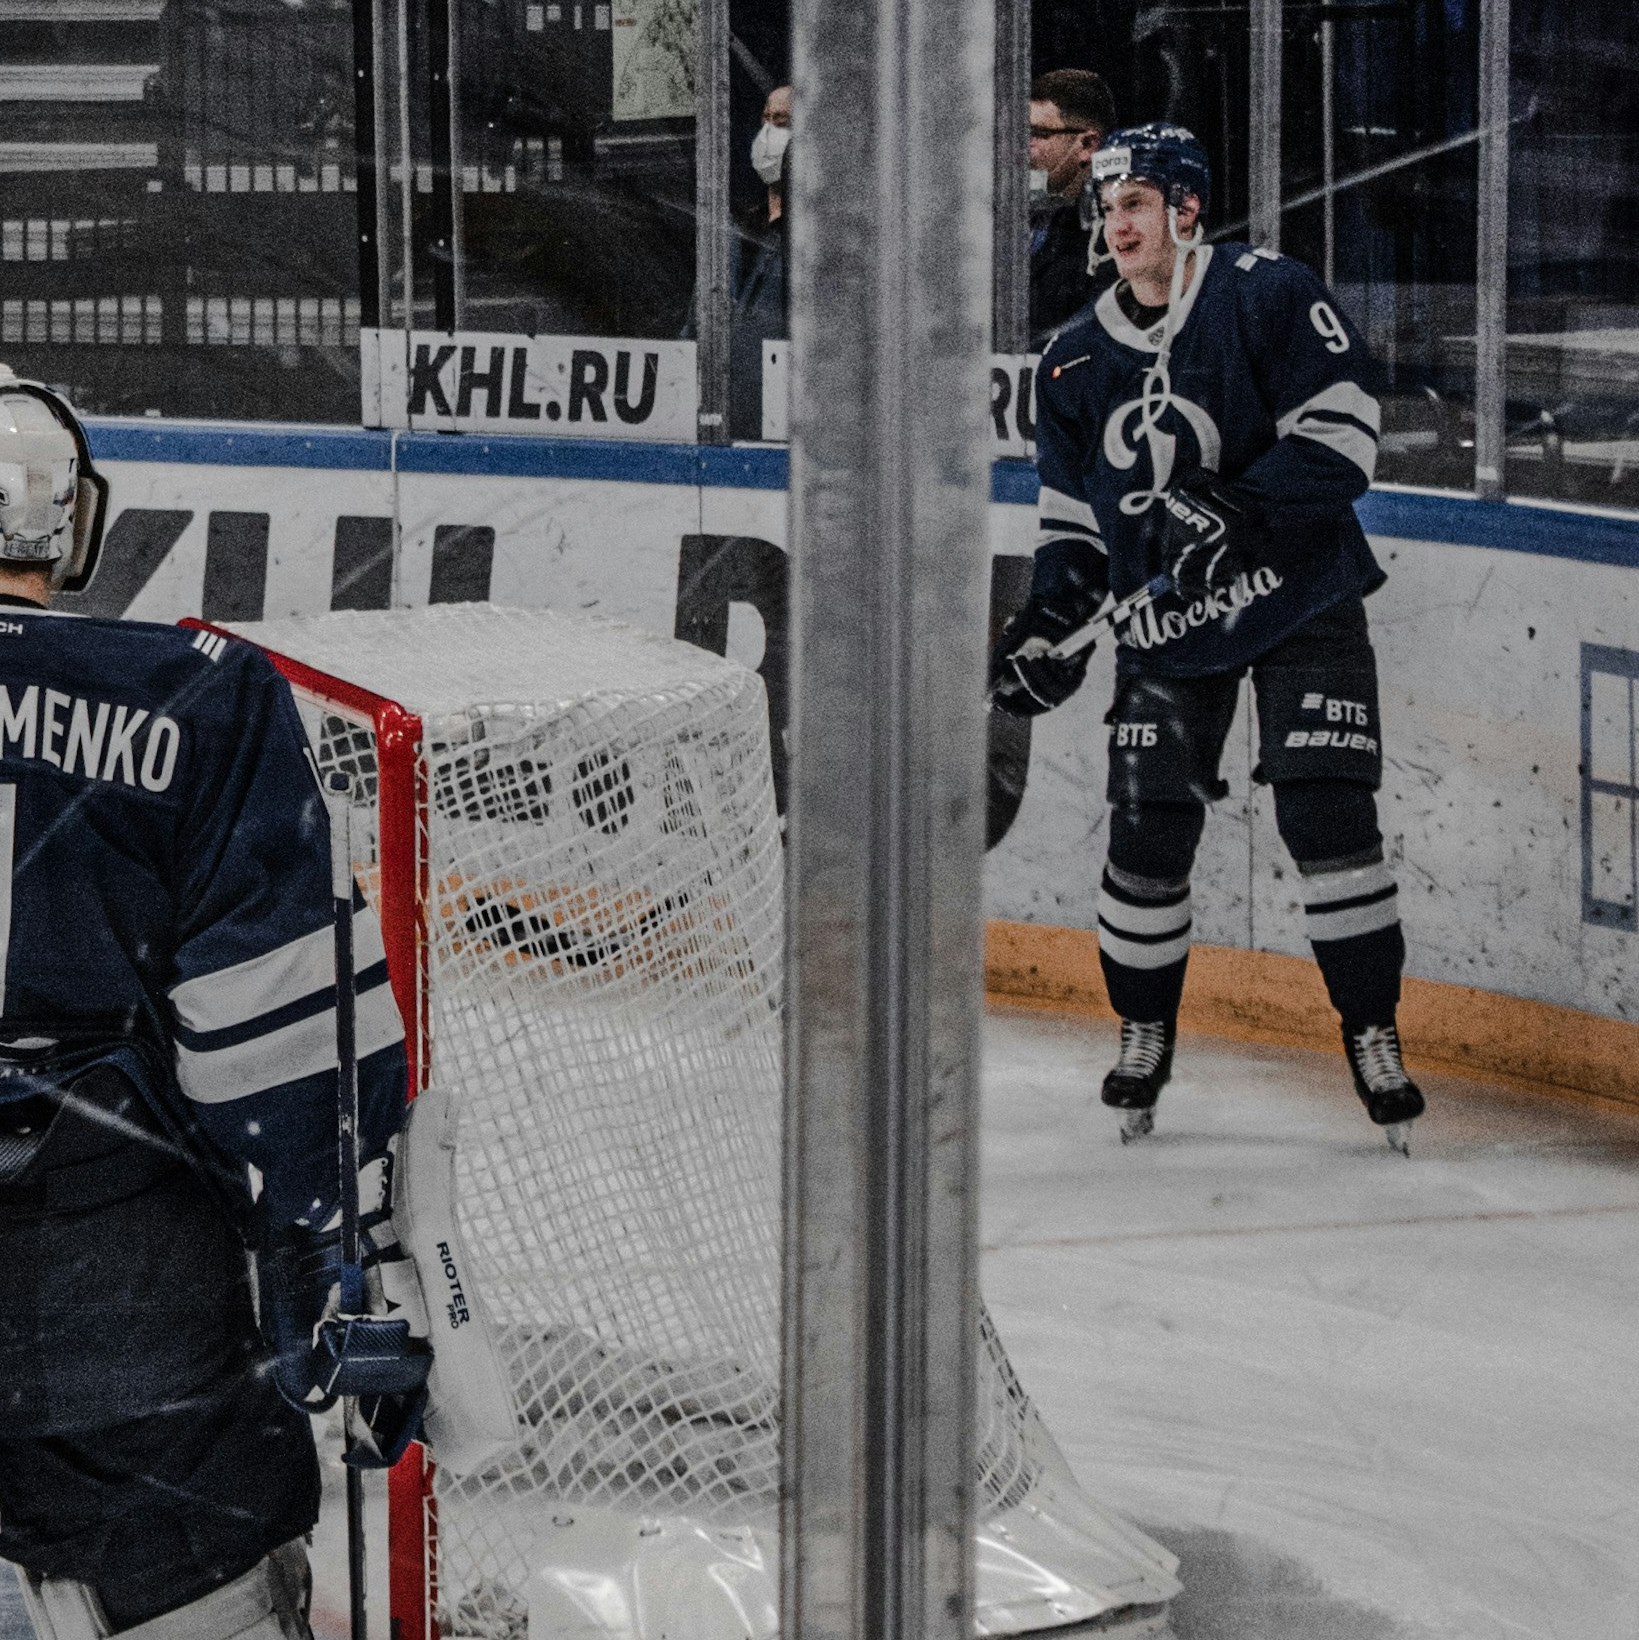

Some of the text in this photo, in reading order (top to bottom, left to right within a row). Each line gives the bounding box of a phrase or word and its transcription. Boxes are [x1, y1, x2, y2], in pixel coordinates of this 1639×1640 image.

[406, 344, 659, 425] KHL.RU
[435, 1241, 471, 1324] RIOTER
[445, 1303, 460, 1330] PRO
